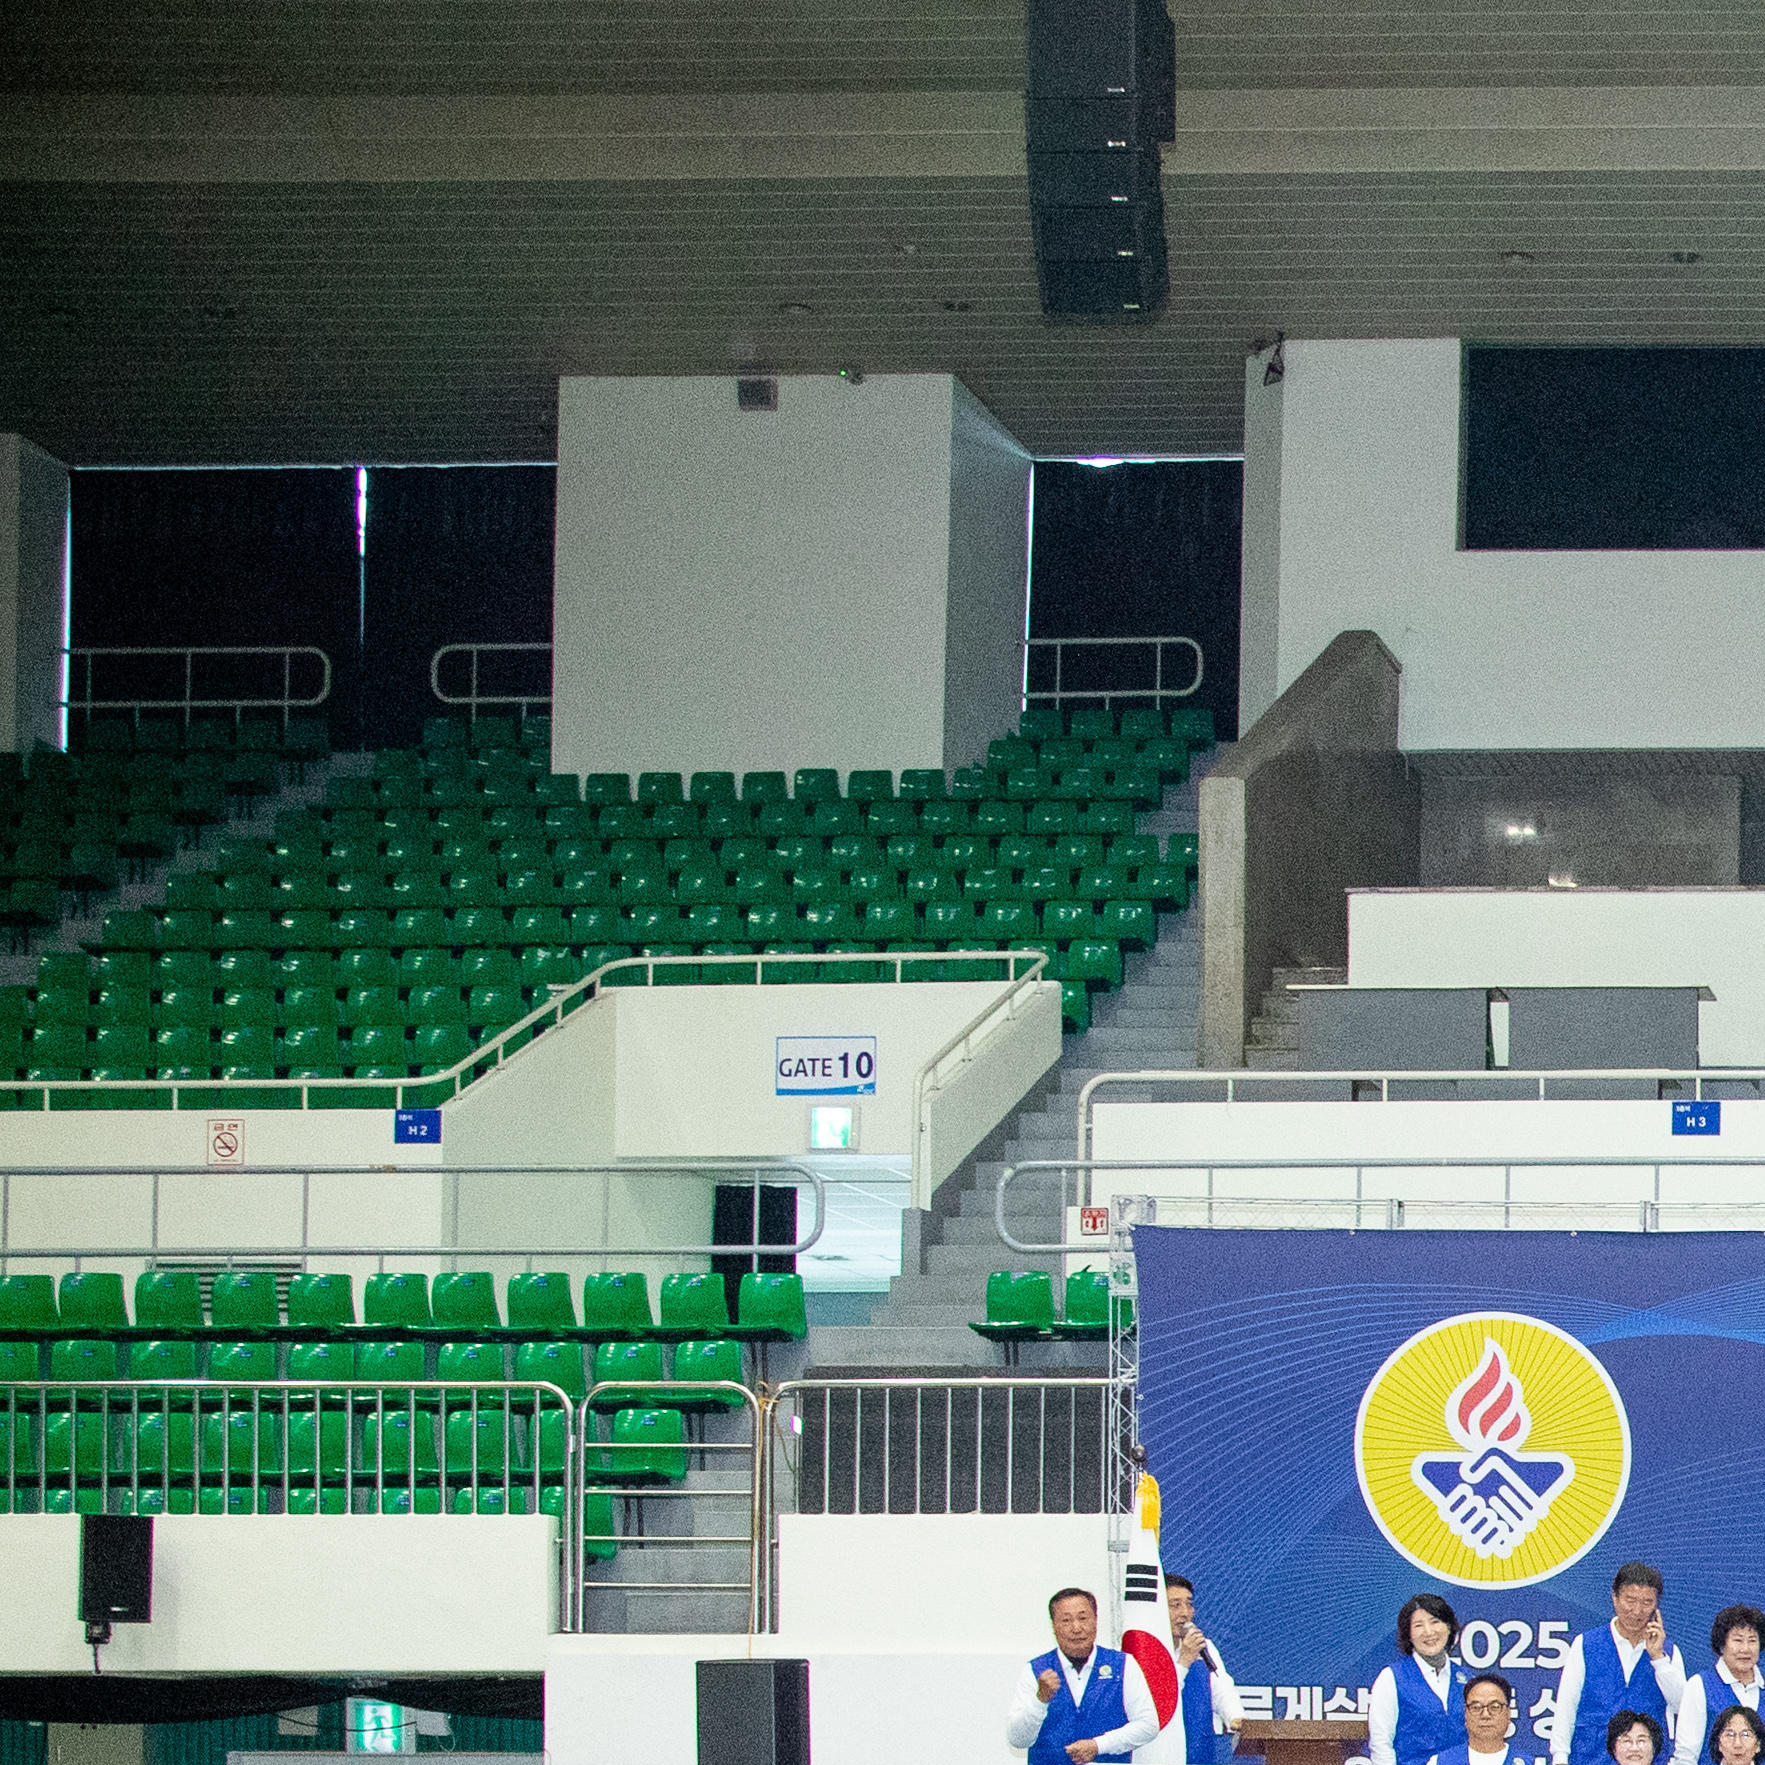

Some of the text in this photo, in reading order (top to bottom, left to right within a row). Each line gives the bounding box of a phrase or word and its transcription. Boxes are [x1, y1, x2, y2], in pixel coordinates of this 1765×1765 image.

[779, 1051, 874, 1079] GATE 10
[1453, 1619, 1572, 1669] 025
